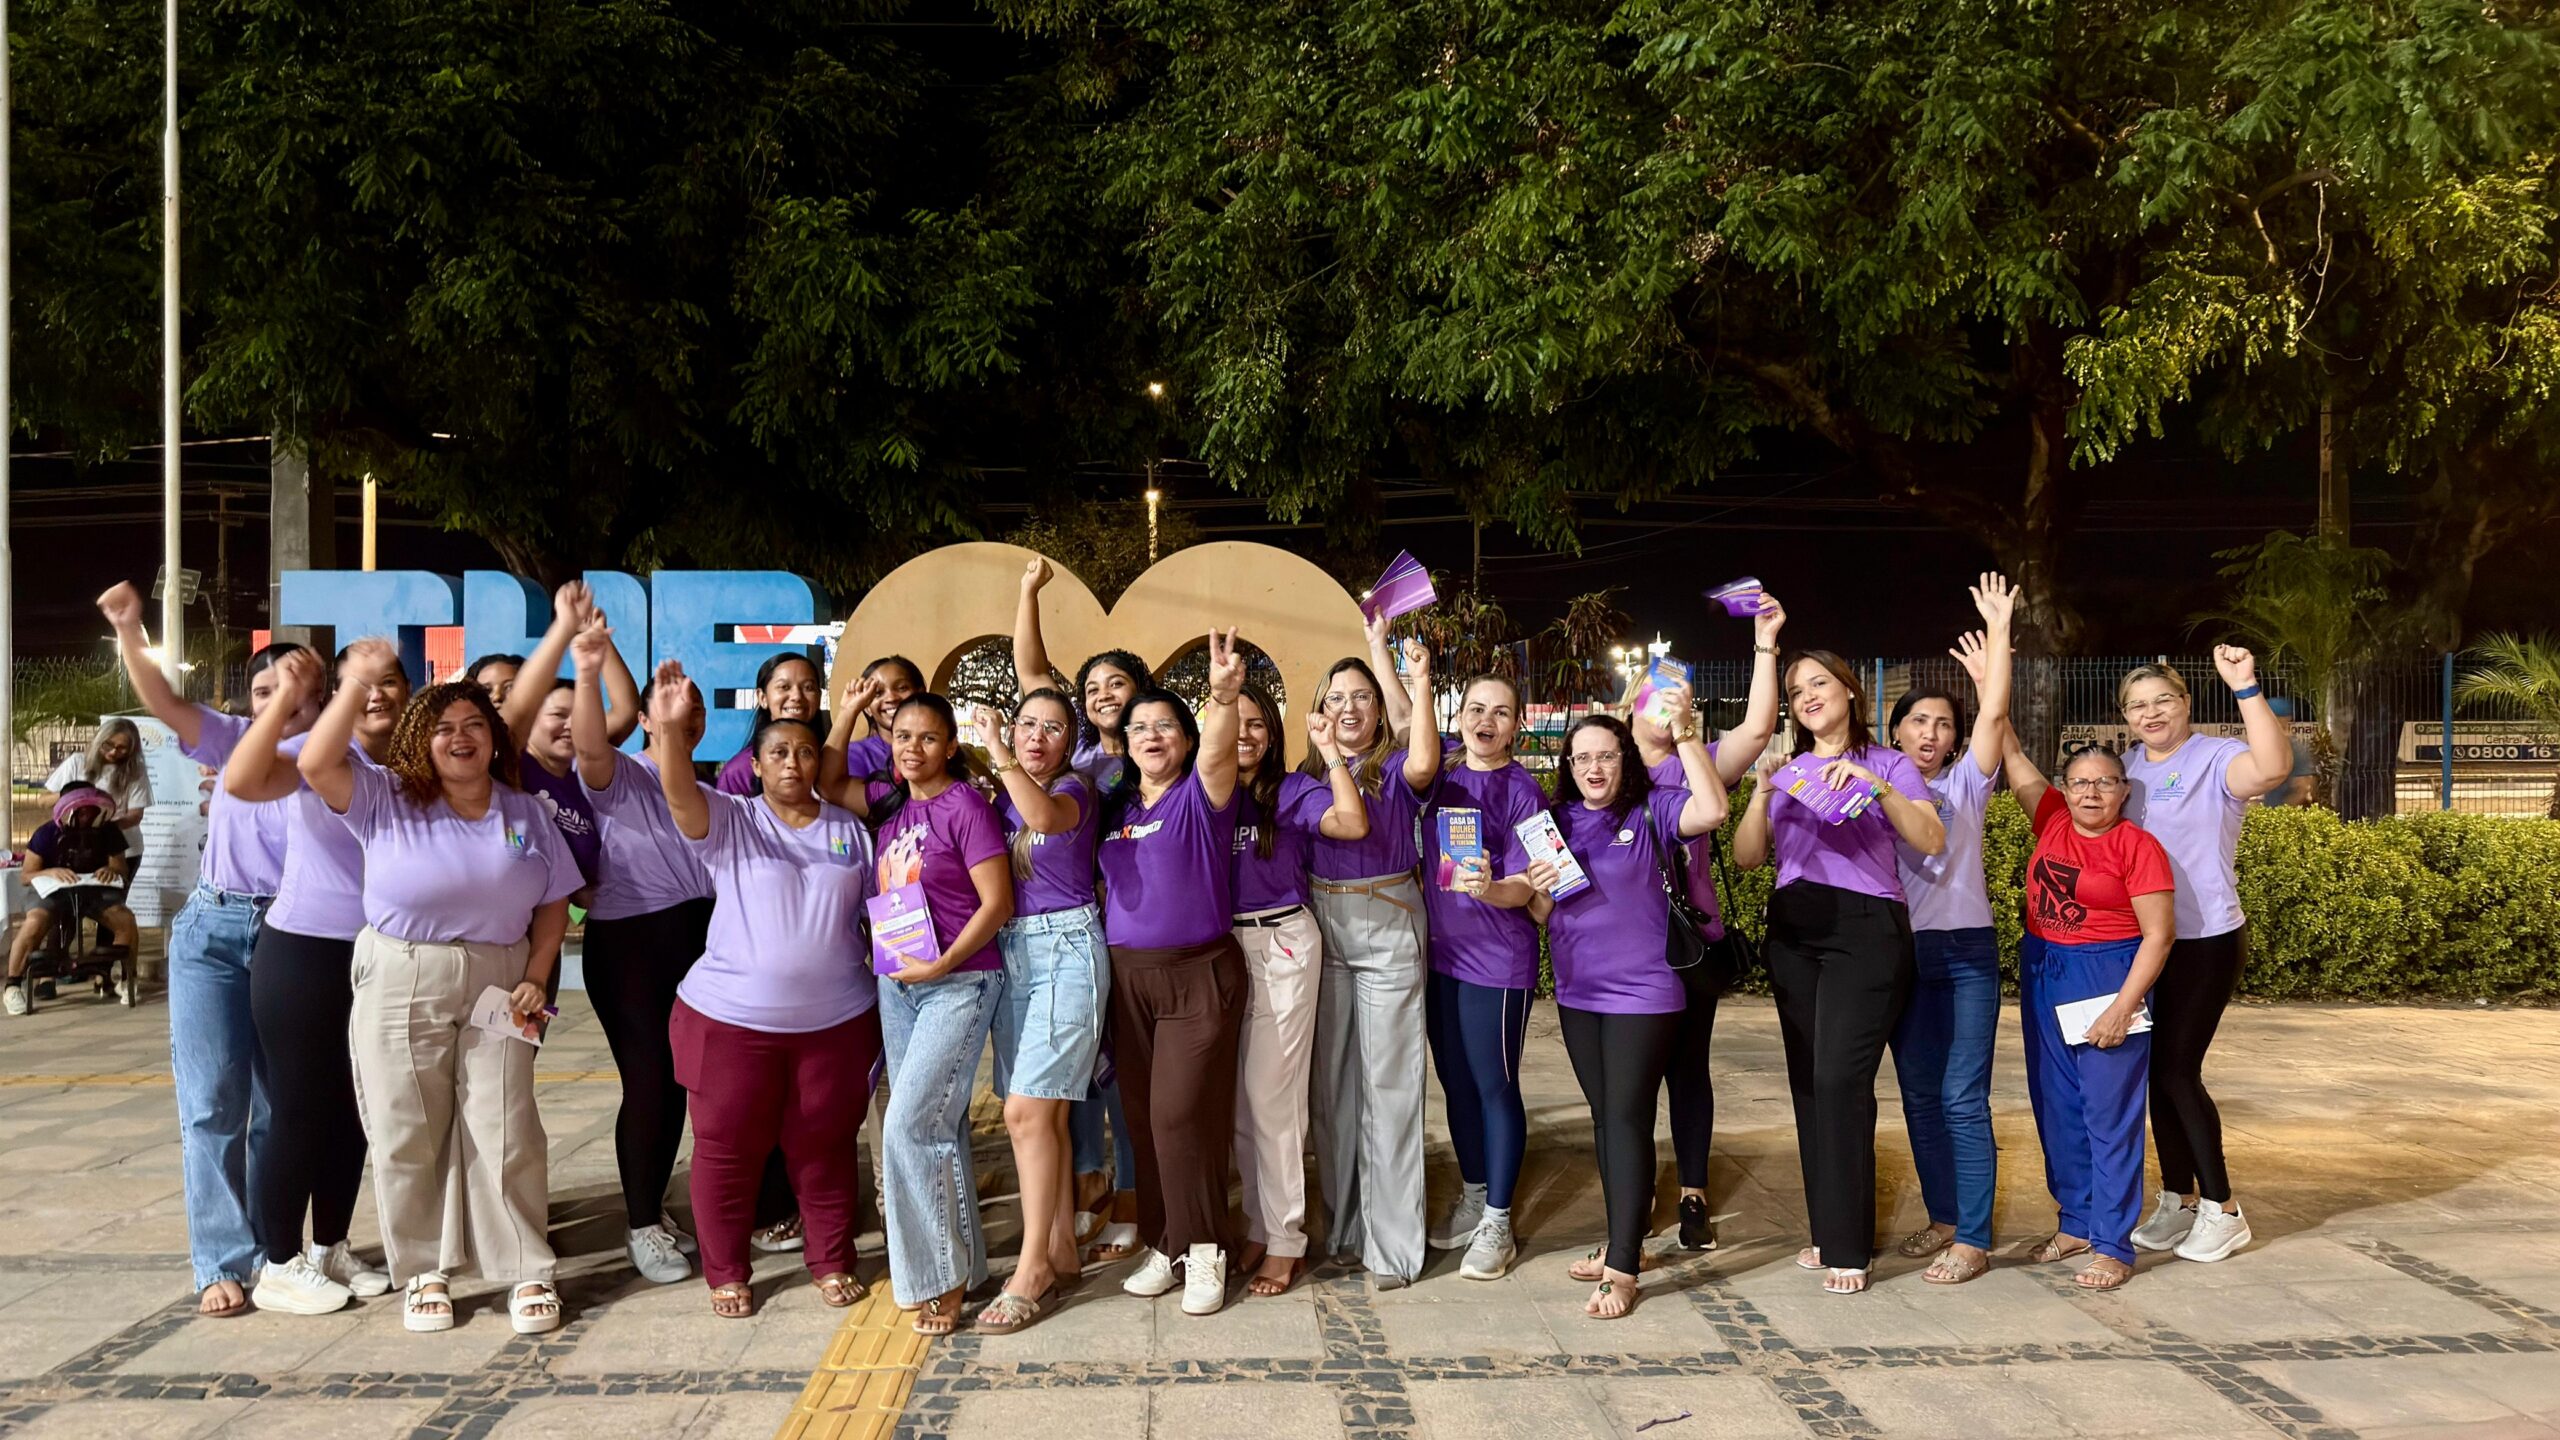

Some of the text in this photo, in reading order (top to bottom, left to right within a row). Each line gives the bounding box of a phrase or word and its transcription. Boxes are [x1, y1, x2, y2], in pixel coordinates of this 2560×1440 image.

[2220, 724, 2248, 736] Plan
[2426, 724, 2444, 734] plan
[2468, 746, 2518, 758] 0800
[1450, 816, 1476, 825] CASA DA
[1450, 825, 1476, 833] MULHER
